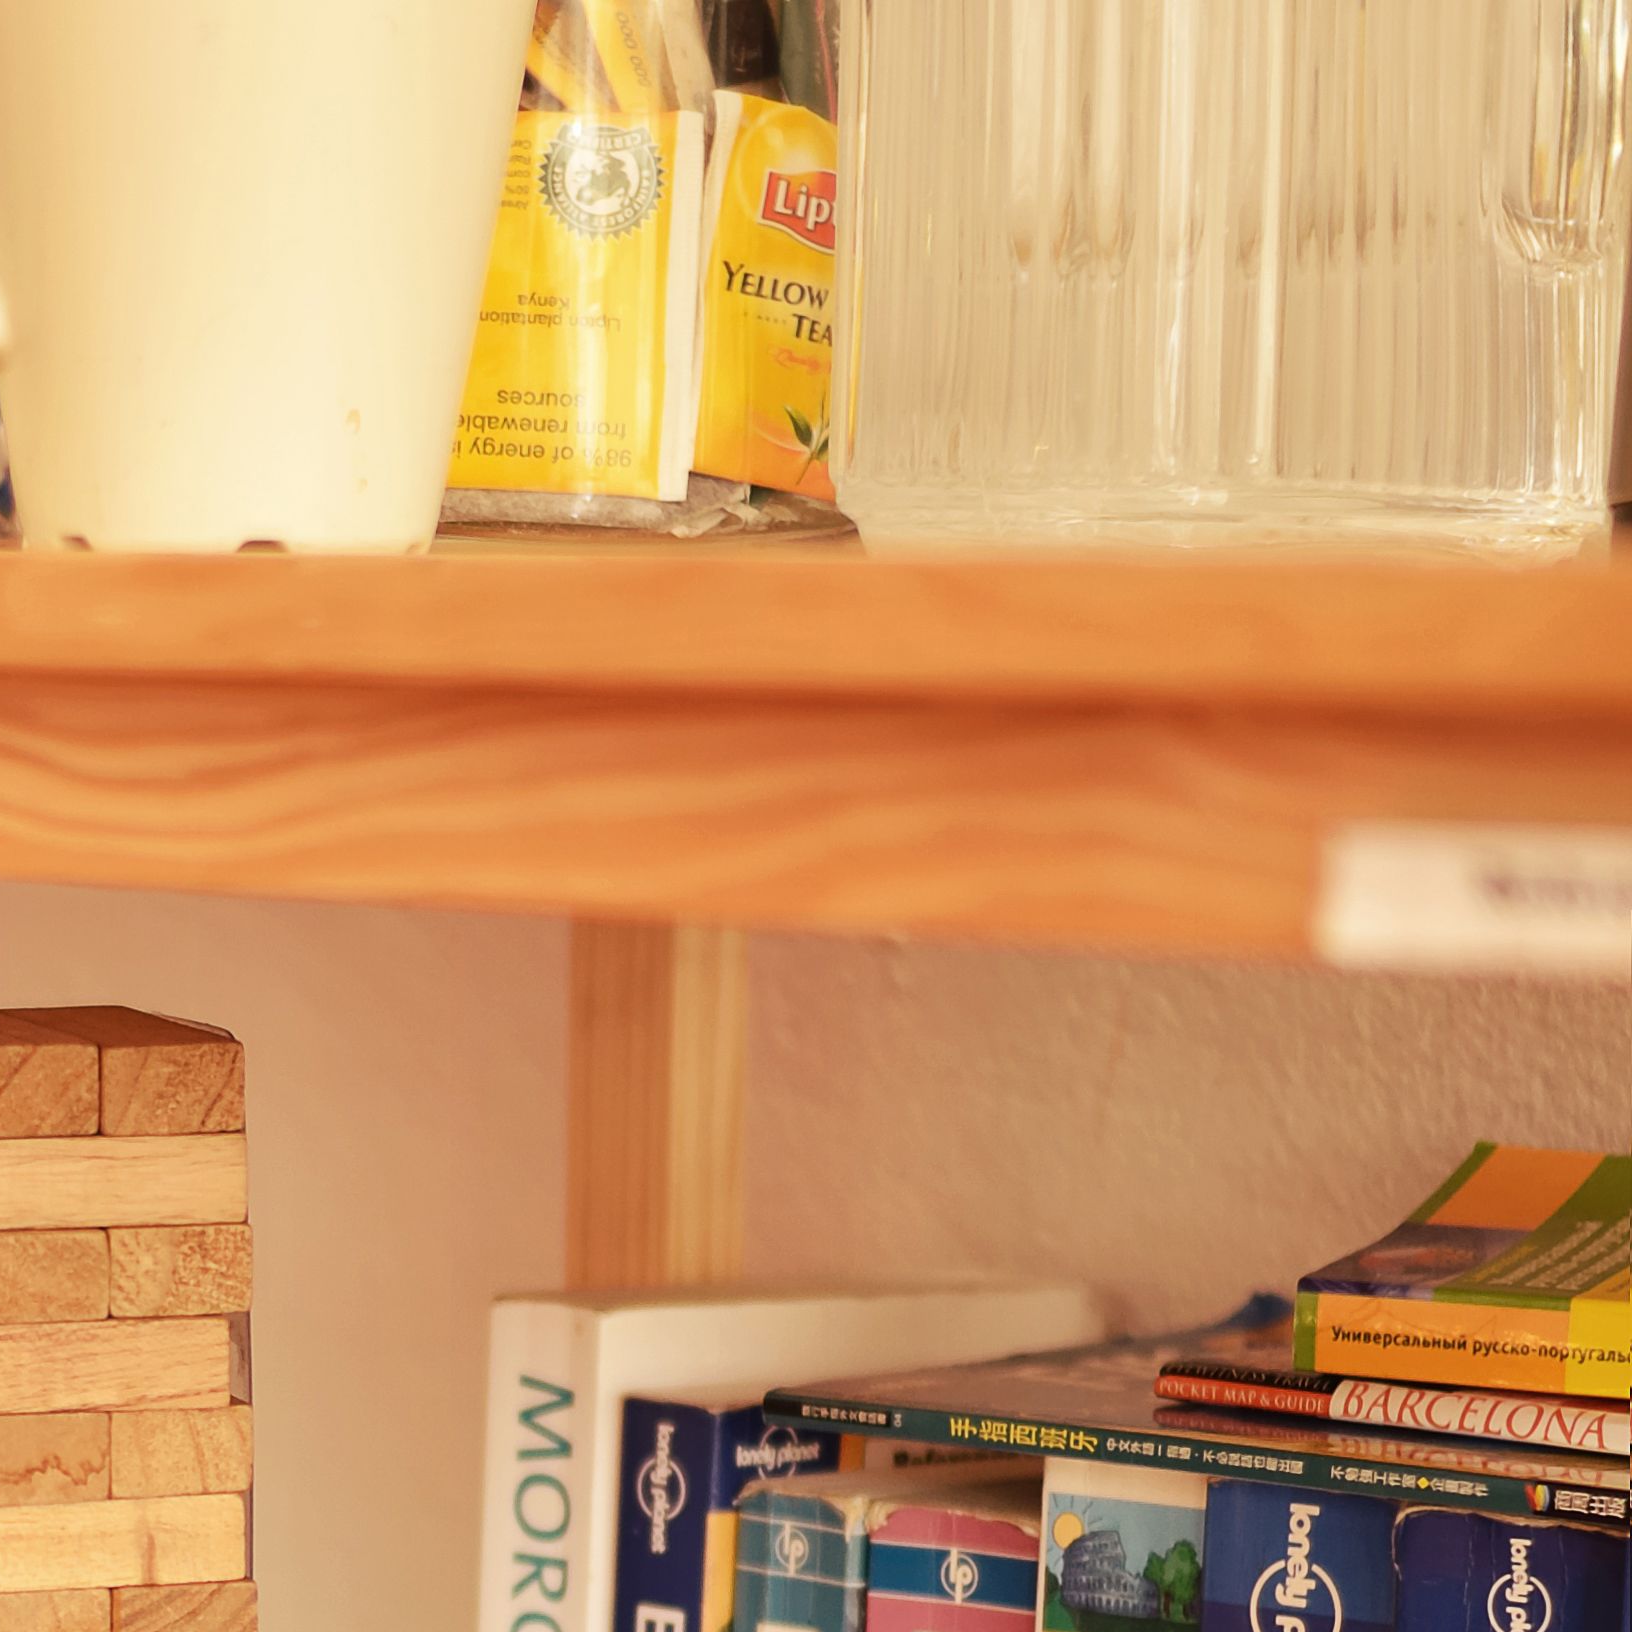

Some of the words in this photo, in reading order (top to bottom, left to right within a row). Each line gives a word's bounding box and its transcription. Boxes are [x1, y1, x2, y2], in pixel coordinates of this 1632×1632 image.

[774, 178, 836, 232] Lip
[517, 291, 571, 310] Kenya
[722, 260, 830, 311] YELLOW
[479, 309, 562, 328] plantation
[568, 314, 622, 332] Lipton
[792, 313, 833, 348] TEA
[496, 389, 586, 408] sources
[575, 421, 627, 441] from
[469, 436, 546, 460] energy
[552, 445, 575, 465] of
[1331, 1325, 1467, 1351] Универсальный
[1158, 1380, 1218, 1401] POCKET
[1222, 1387, 1258, 1406] MAP
[1259, 1394, 1272, 1408] &
[1273, 1393, 1327, 1414] GUIDE
[1340, 1380, 1610, 1451] BARCELONA
[949, 1416, 1099, 1454] 手指西班牙
[650, 1421, 676, 1487] lonely
[1554, 1489, 1628, 1520] 商周出版
[1274, 1503, 1320, 1609] lonely
[1505, 1537, 1534, 1604] lonely
